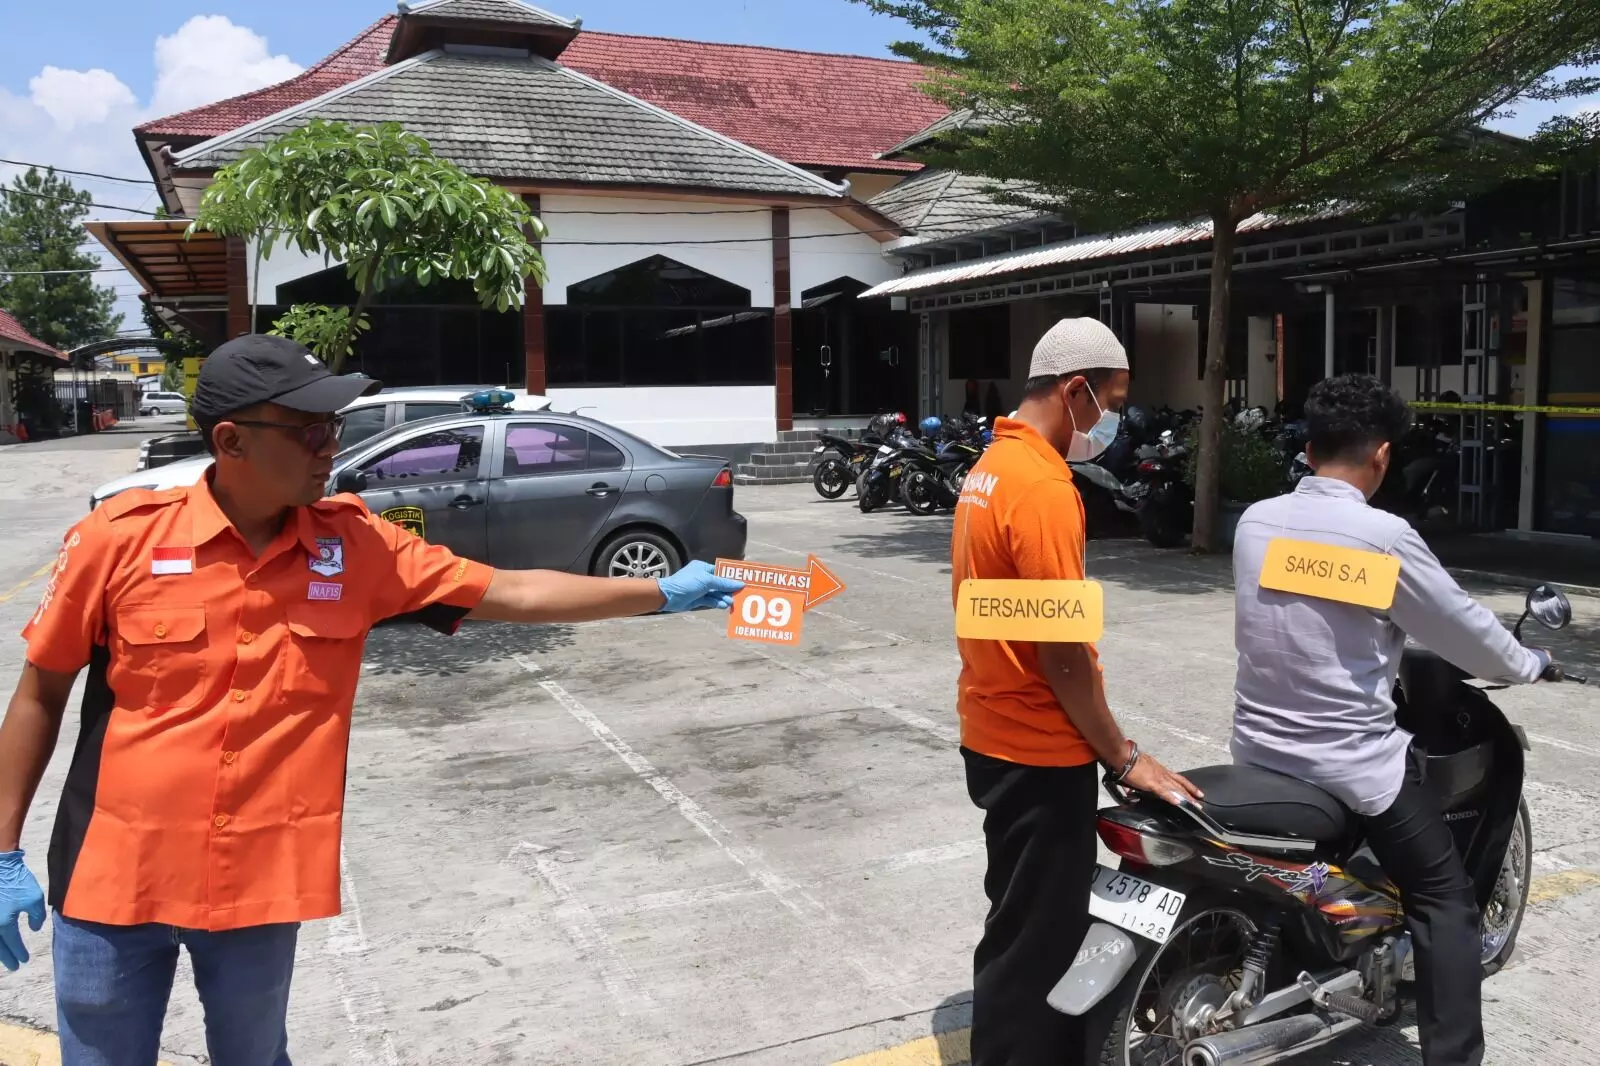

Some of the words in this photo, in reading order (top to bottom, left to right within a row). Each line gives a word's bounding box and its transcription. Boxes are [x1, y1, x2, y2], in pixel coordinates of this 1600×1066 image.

[721, 565, 811, 588] IDENTIFIKASI
[1285, 555, 1334, 579] SAKSI
[1338, 564, 1367, 585] S.A
[310, 585, 340, 597] INAFIS
[742, 594, 792, 627] 09
[970, 597, 1085, 618] TERSANGKA
[735, 625, 793, 640] IDENTIFIKASI
[1443, 809, 1479, 821] HONDA
[1106, 874, 1152, 903] 4578
[1156, 892, 1183, 916] AD
